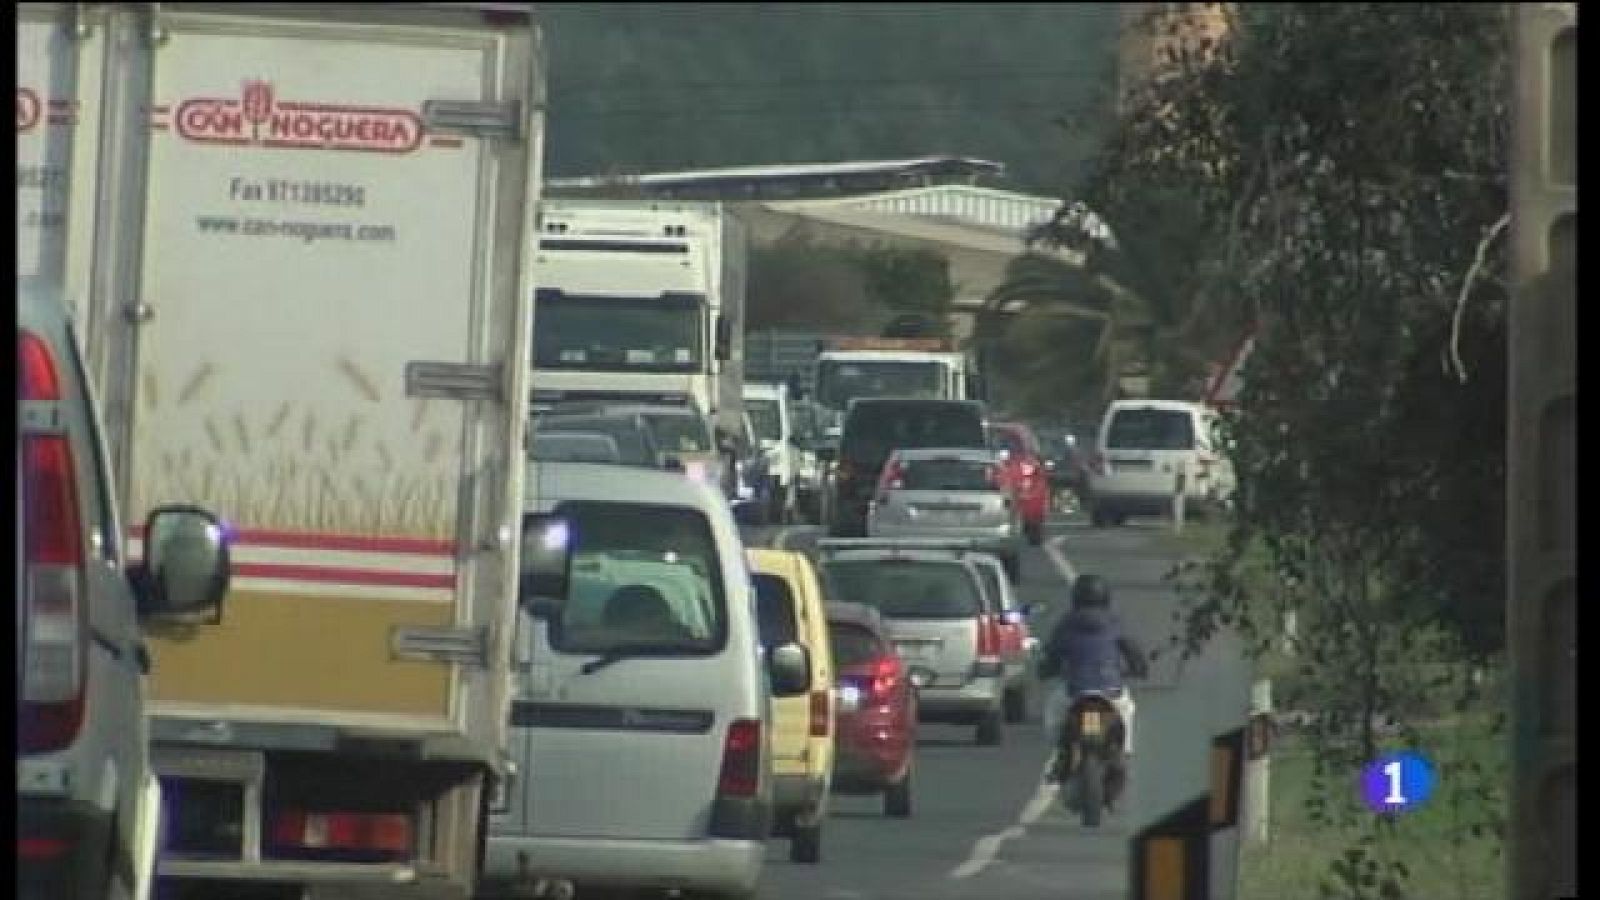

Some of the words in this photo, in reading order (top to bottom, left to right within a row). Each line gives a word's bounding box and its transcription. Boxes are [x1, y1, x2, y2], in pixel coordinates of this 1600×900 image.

[270, 113, 409, 142] NOGUERA
[229, 177, 262, 202] Fax
[197, 216, 395, 243] www.can-noguera.com
